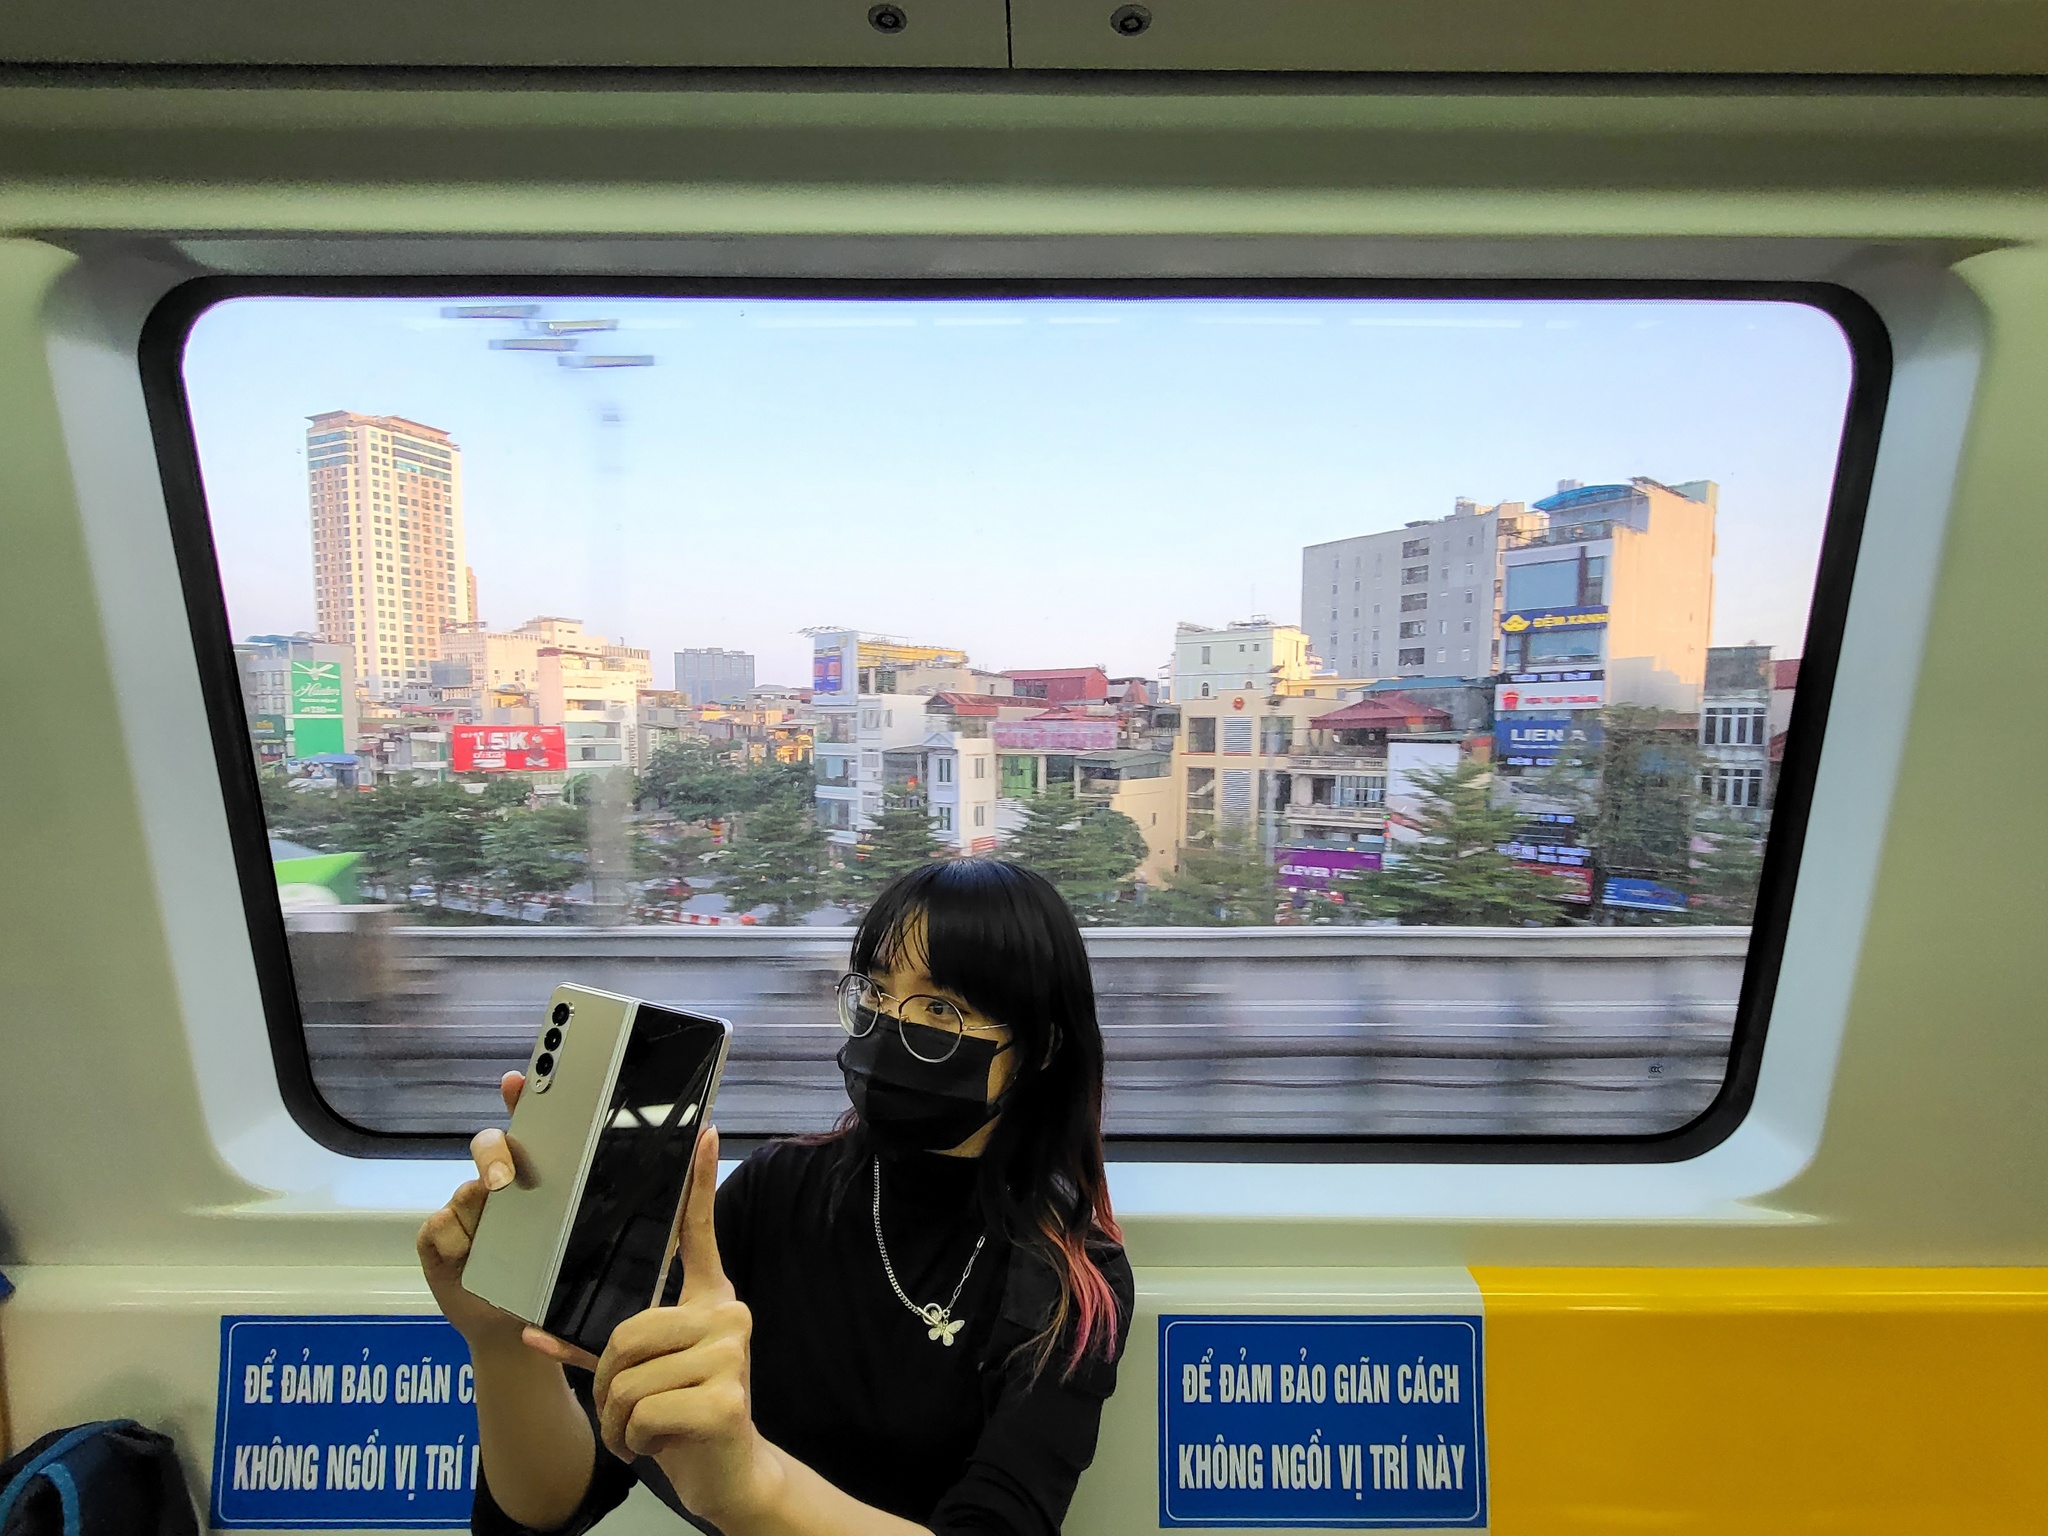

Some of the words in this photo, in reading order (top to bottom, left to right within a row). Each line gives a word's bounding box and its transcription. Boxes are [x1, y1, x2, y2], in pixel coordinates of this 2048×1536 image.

[244, 1348, 277, 1404] ĐỂ
[281, 1347, 335, 1404] ĐẢM
[341, 1347, 388, 1404] BẢO
[395, 1356, 451, 1404] GIÃN
[1182, 1347, 1214, 1404] ĐỂ
[1219, 1347, 1272, 1404] ĐẢM
[1280, 1347, 1327, 1404] BẢO
[1334, 1356, 1390, 1404] GIÃN
[1397, 1356, 1460, 1404] CÁCH
[233, 1435, 320, 1491] KHÔNG
[325, 1428, 387, 1491] NGỒI
[394, 1444, 418, 1501] VỊ
[425, 1434, 465, 1491] TRÍ
[1178, 1434, 1264, 1489] KHÔNG
[1271, 1428, 1331, 1490] NGỒI
[1338, 1444, 1363, 1501] VỊ
[1369, 1434, 1408, 1490] TRÍ
[1415, 1434, 1466, 1490] NÀY
